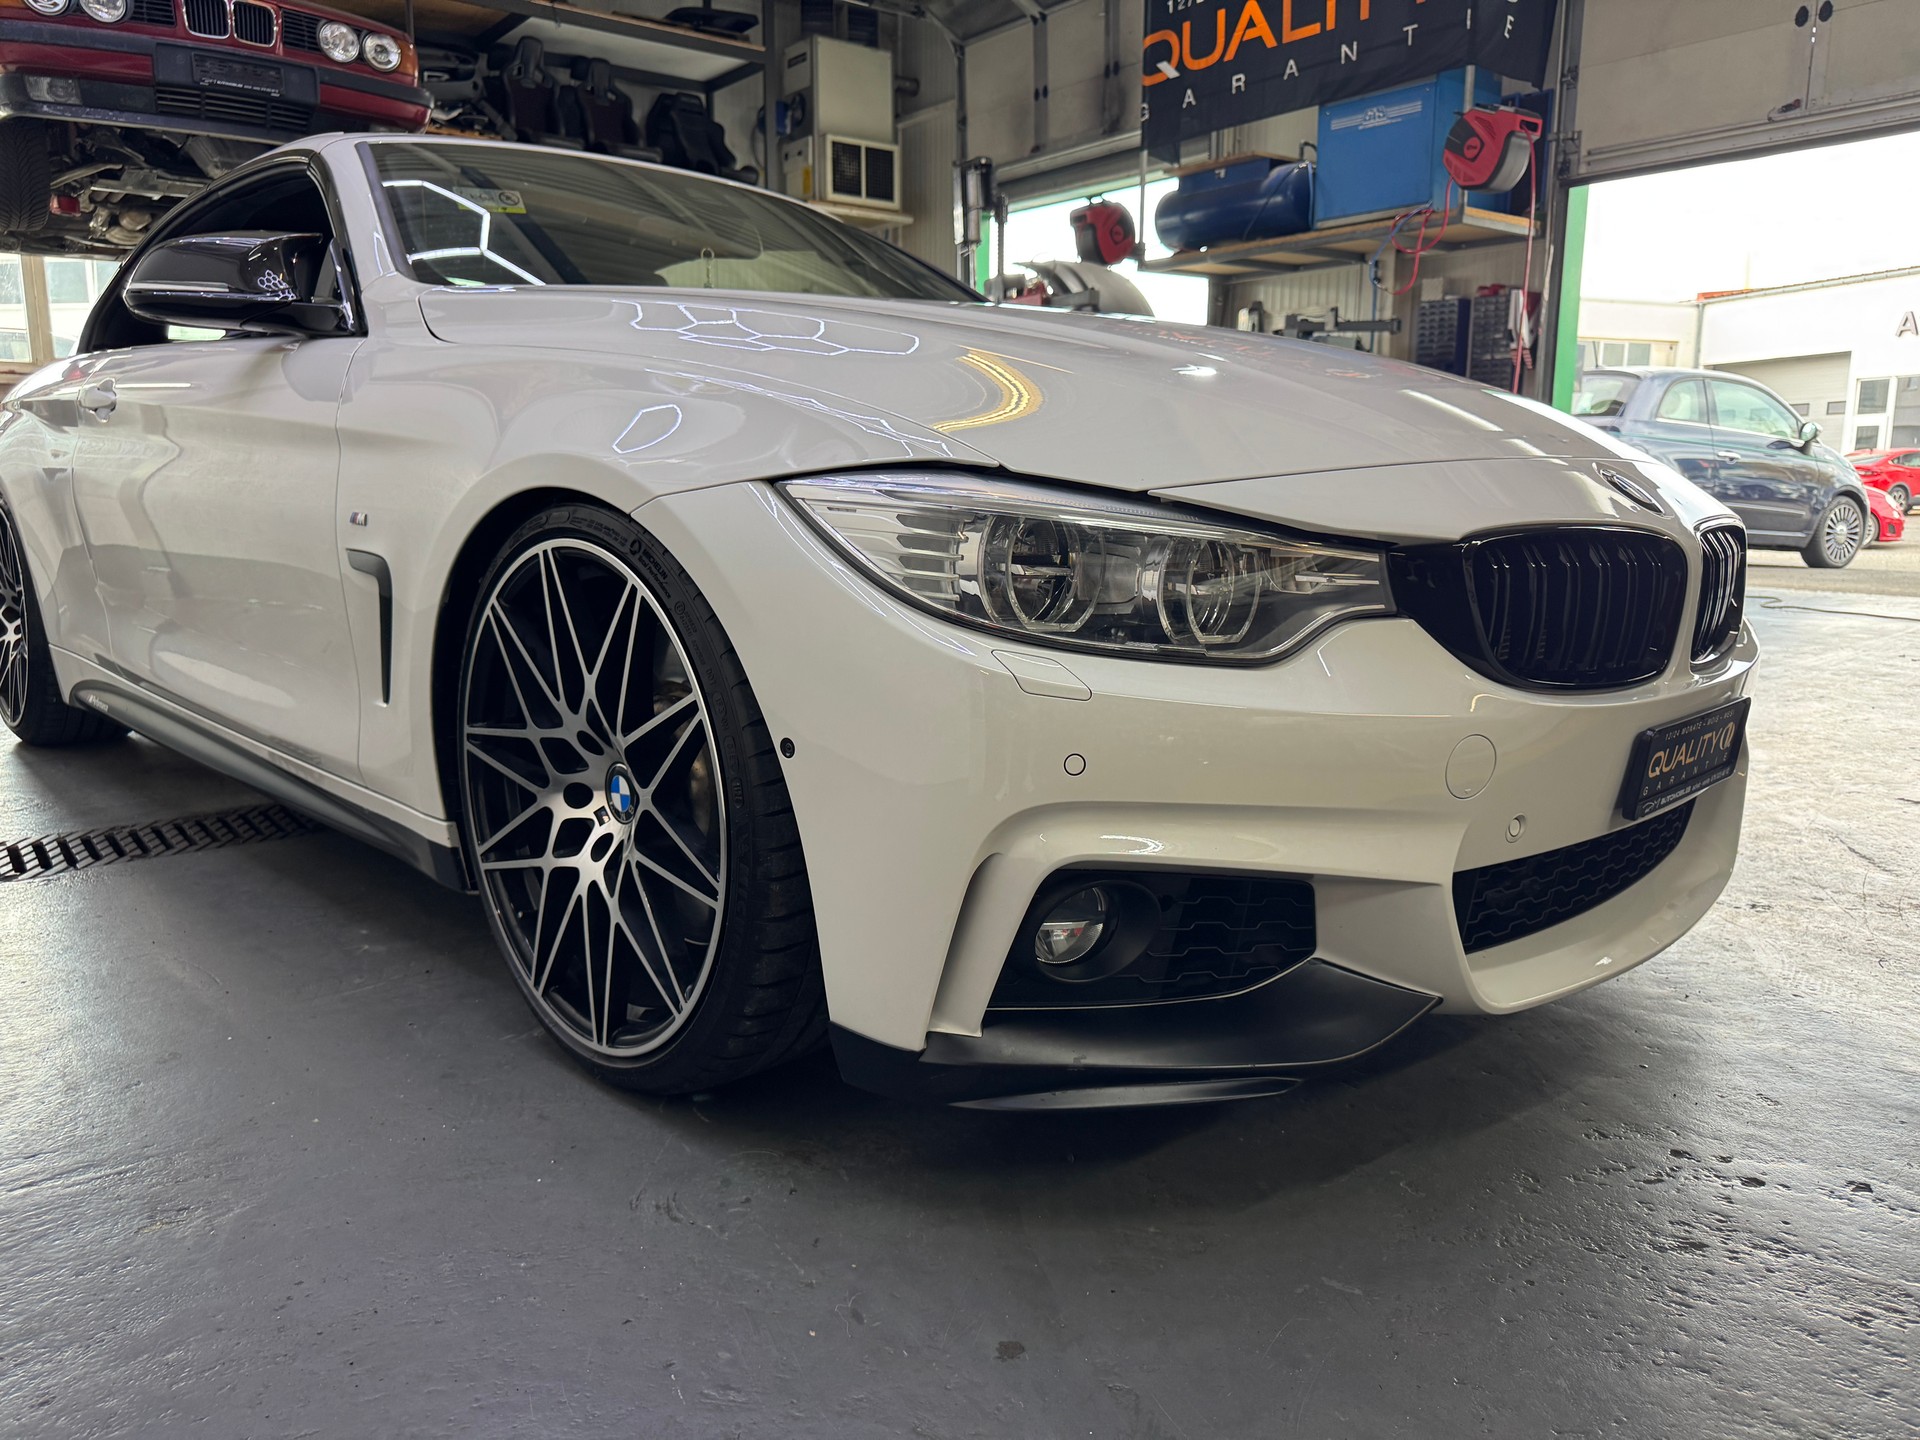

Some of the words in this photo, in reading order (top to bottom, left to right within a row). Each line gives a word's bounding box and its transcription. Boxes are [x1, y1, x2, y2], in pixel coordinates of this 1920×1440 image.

[641, 547, 669, 580] MICHELIN
[1642, 752, 1728, 796] GARANTIE
[1648, 727, 1723, 779] QUALITY
